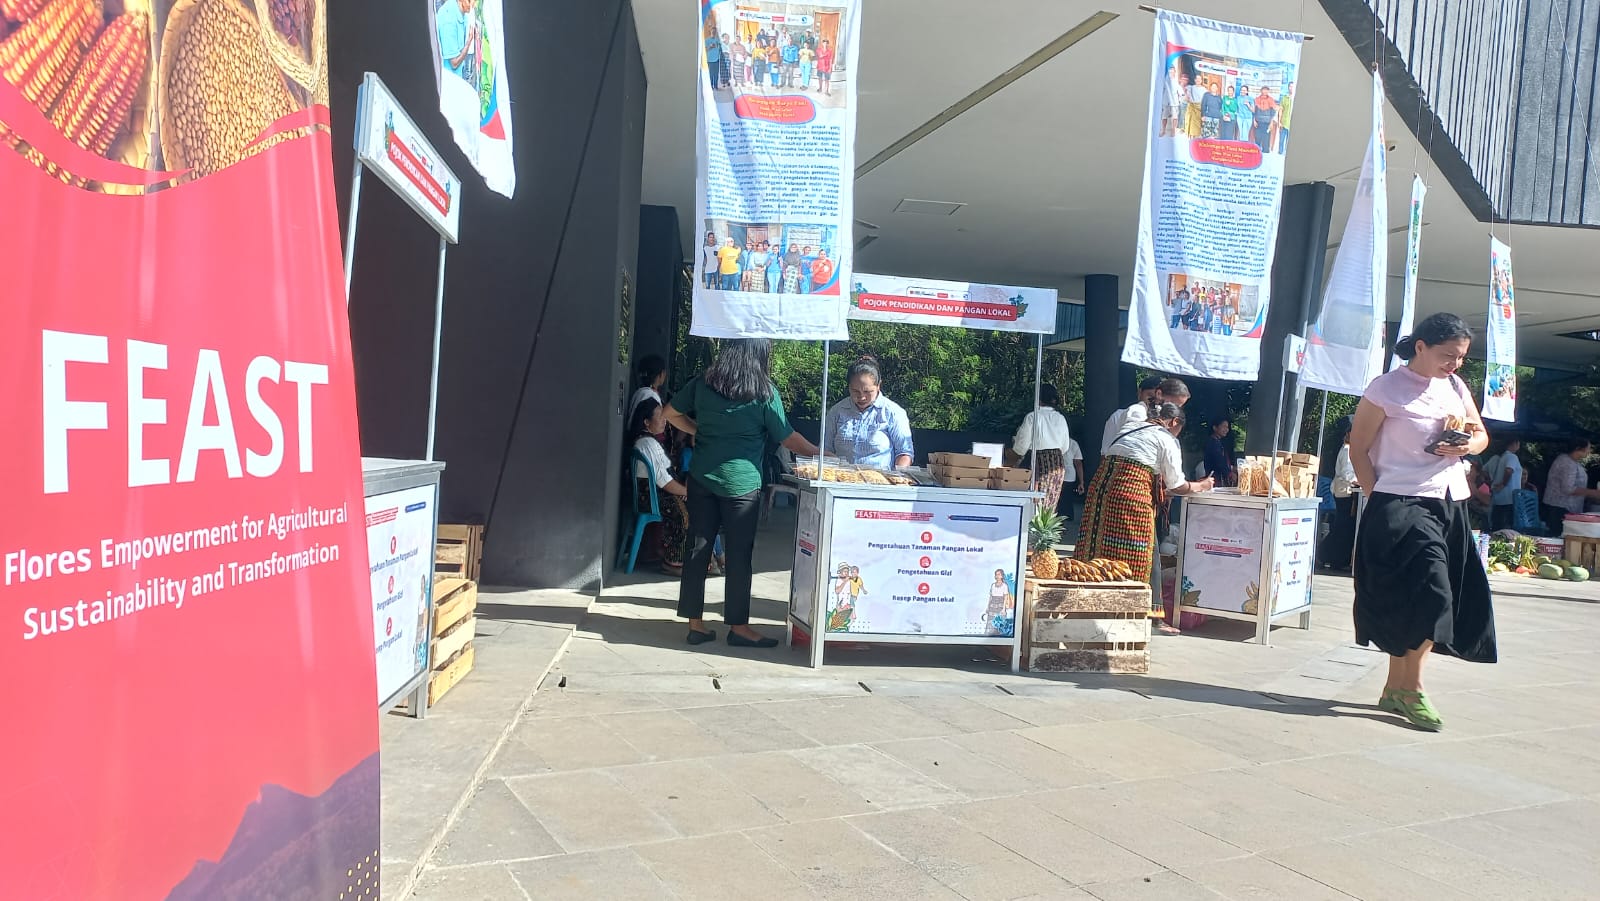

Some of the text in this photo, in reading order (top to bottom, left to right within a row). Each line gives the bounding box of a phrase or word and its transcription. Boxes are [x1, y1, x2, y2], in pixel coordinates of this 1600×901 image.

[863, 298, 1012, 317] POJOK PENDIDIKAN DAN PANGAN LOKAL
[42, 328, 329, 494] FEAST
[855, 510, 878, 519] FEAST
[4, 547, 92, 586] Flores
[100, 520, 239, 570] Empowerment
[241, 515, 264, 540] for
[267, 501, 348, 540] Agricultural
[867, 542, 911, 550] Pengetahuan
[941, 545, 965, 553] Pangan
[897, 568, 940, 576] Pengetahuan
[23, 543, 340, 640] Sustainability and Transformation
[912, 595, 936, 603] Pangan
